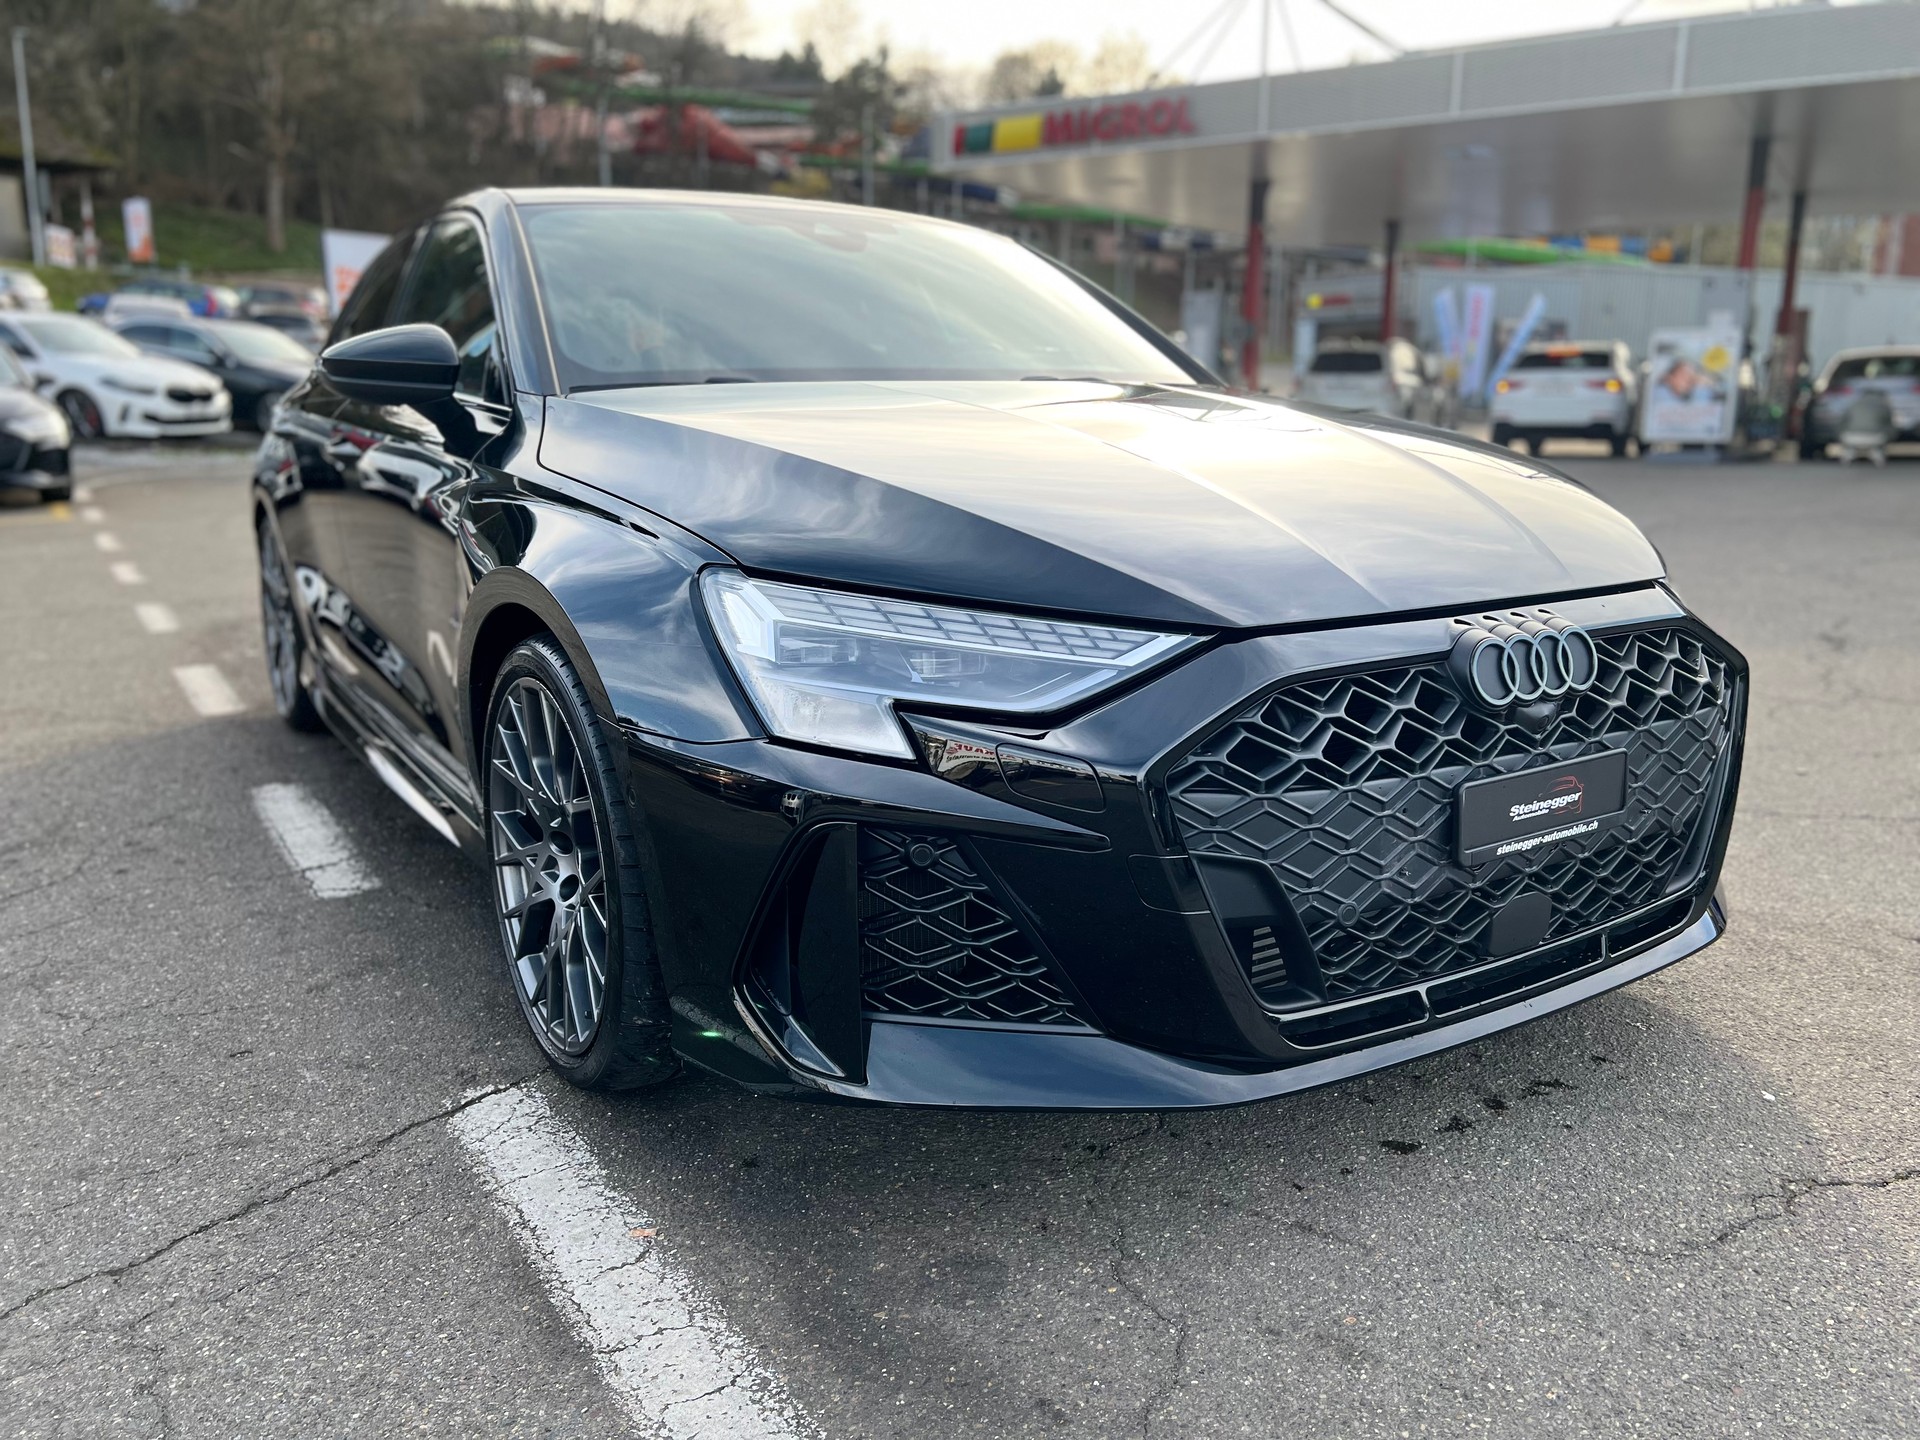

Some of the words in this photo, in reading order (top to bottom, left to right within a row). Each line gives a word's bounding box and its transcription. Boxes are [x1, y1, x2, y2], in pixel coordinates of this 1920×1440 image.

[1045, 97, 1196, 145] MIGROL
[1510, 792, 1582, 816] Steinegger
[1513, 809, 1549, 821] Automobile
[1497, 820, 1598, 855] steinegger-automobile.ch
